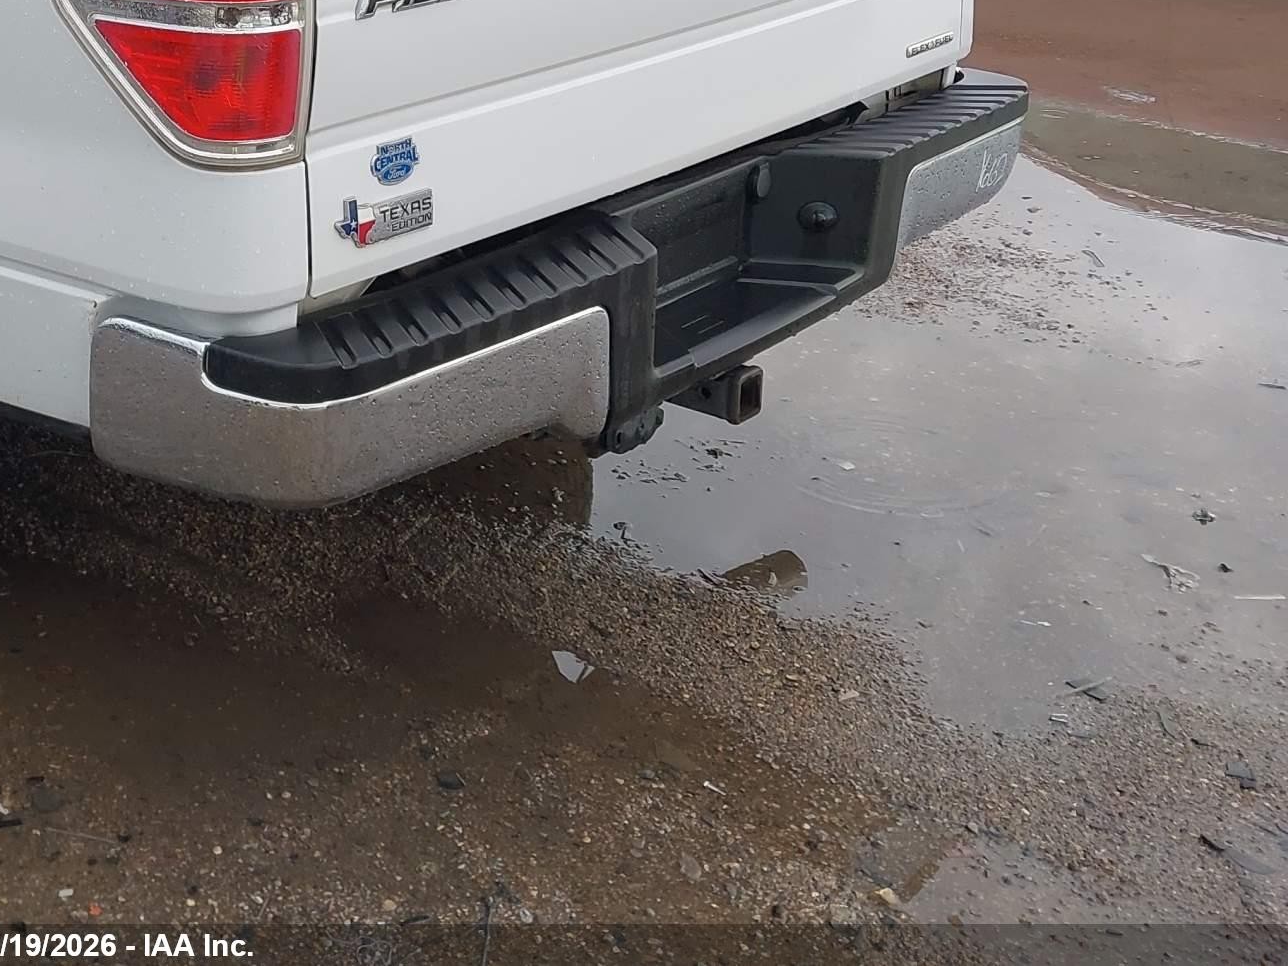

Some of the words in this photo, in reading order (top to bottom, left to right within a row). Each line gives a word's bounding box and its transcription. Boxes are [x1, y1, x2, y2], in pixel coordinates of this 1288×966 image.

[379, 137, 412, 155] NORTH
[374, 146, 419, 172] CENTRAL
[378, 197, 432, 223] TEXAS
[391, 212, 432, 232] EDITION
